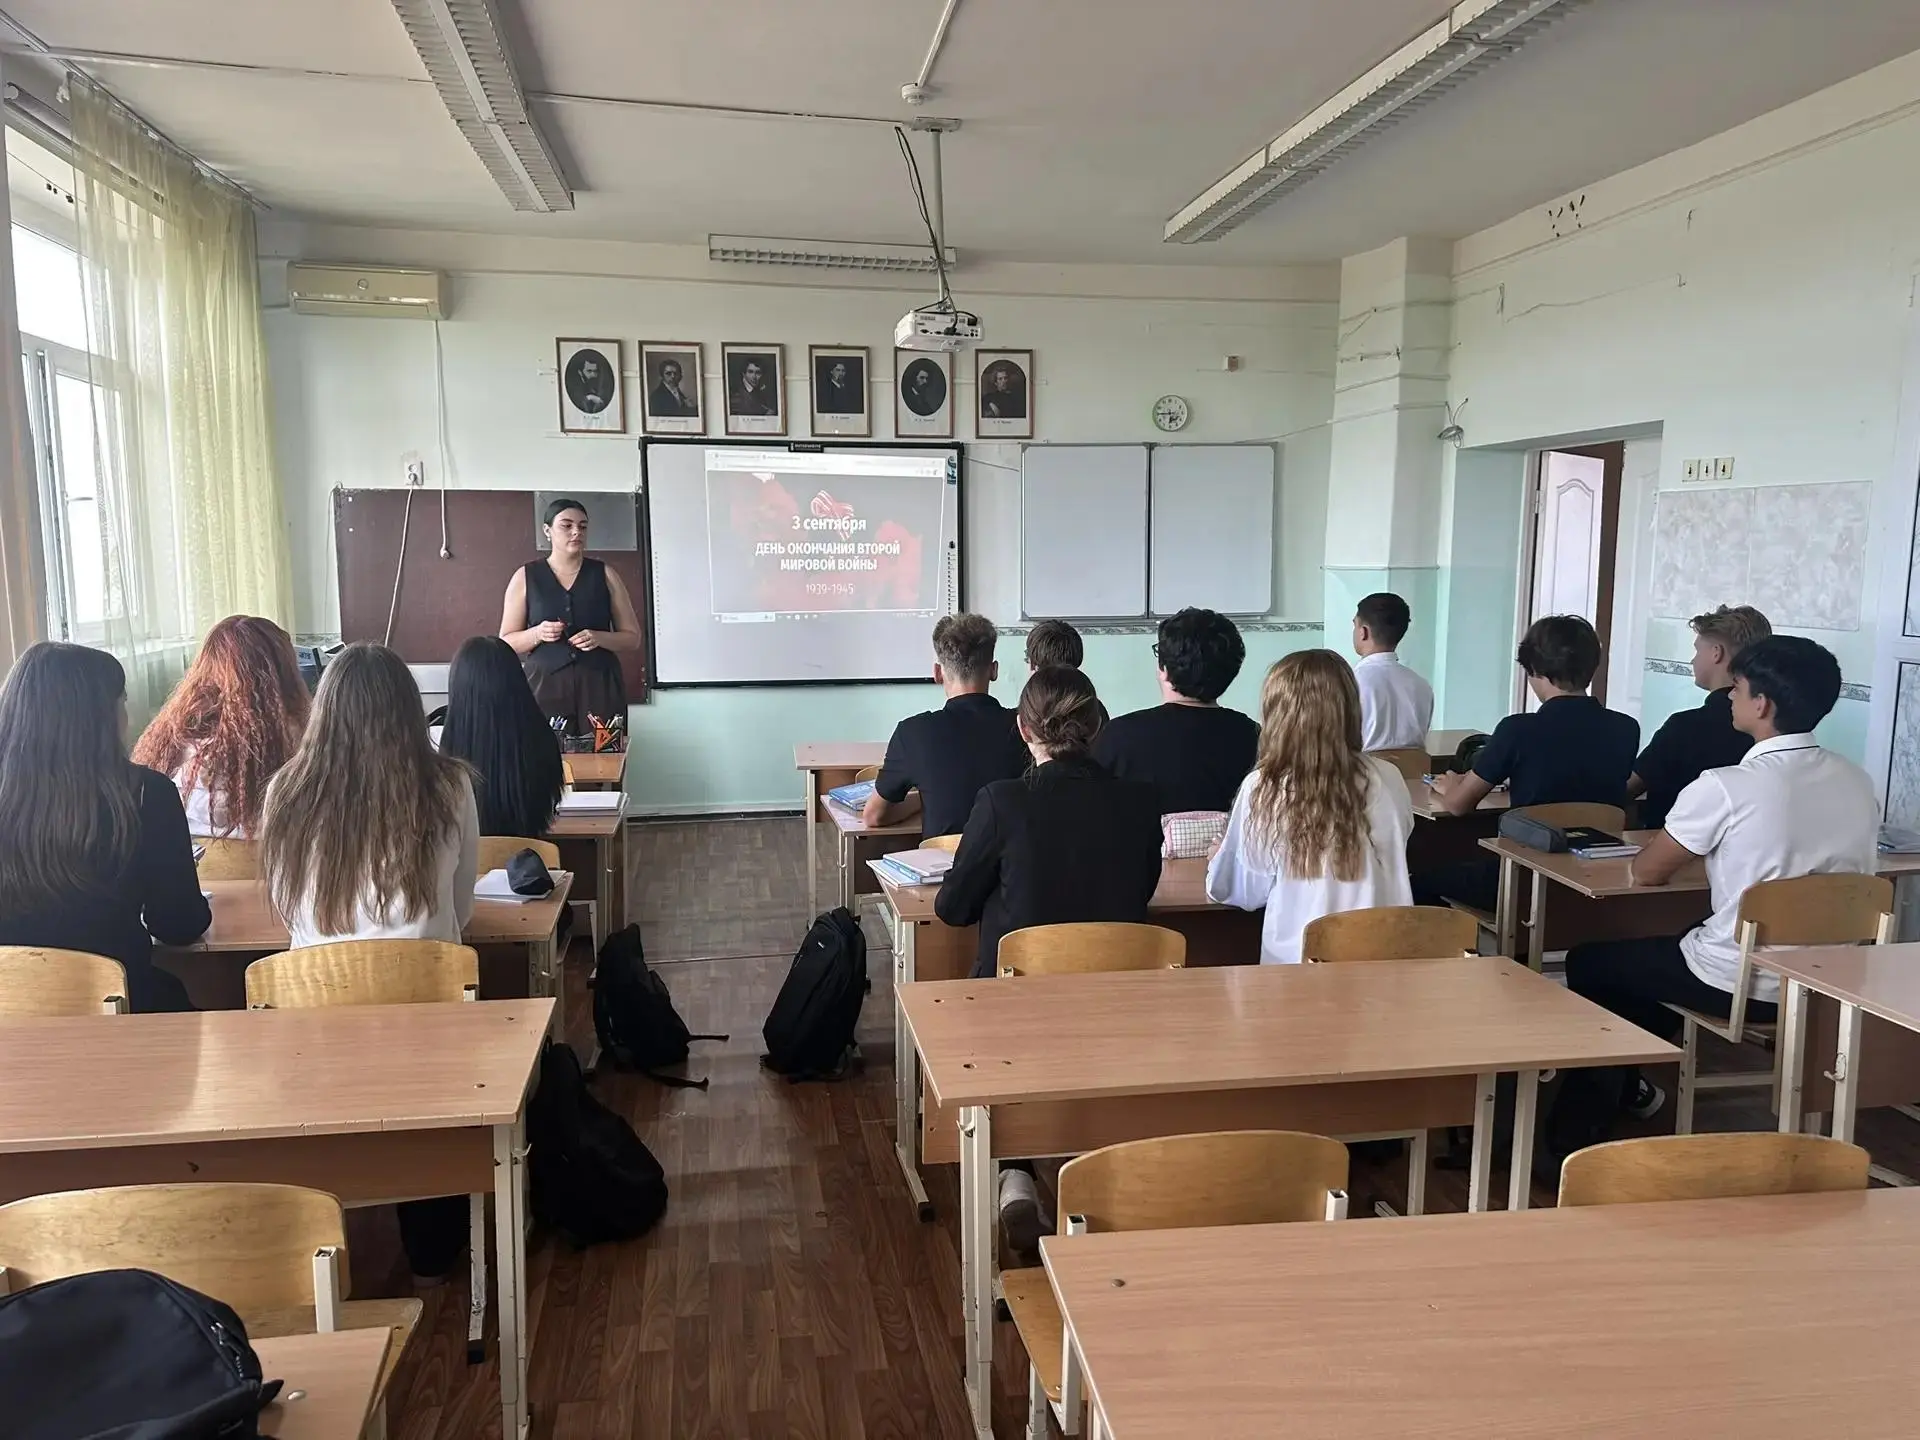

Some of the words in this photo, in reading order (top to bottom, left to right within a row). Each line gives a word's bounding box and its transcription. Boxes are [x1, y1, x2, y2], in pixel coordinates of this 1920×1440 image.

[792, 515, 801, 530] 3
[803, 515, 867, 533] сентября
[755, 542, 785, 556] ДЕНЬ
[787, 542, 855, 555] ОКОНЧАНИЯ
[857, 540, 900, 555] ВТОРОЙ
[780, 556, 836, 571] МИРОВОЙ
[837, 556, 877, 571] ВОЙНЫ
[805, 583, 854, 595] 1939-1945
